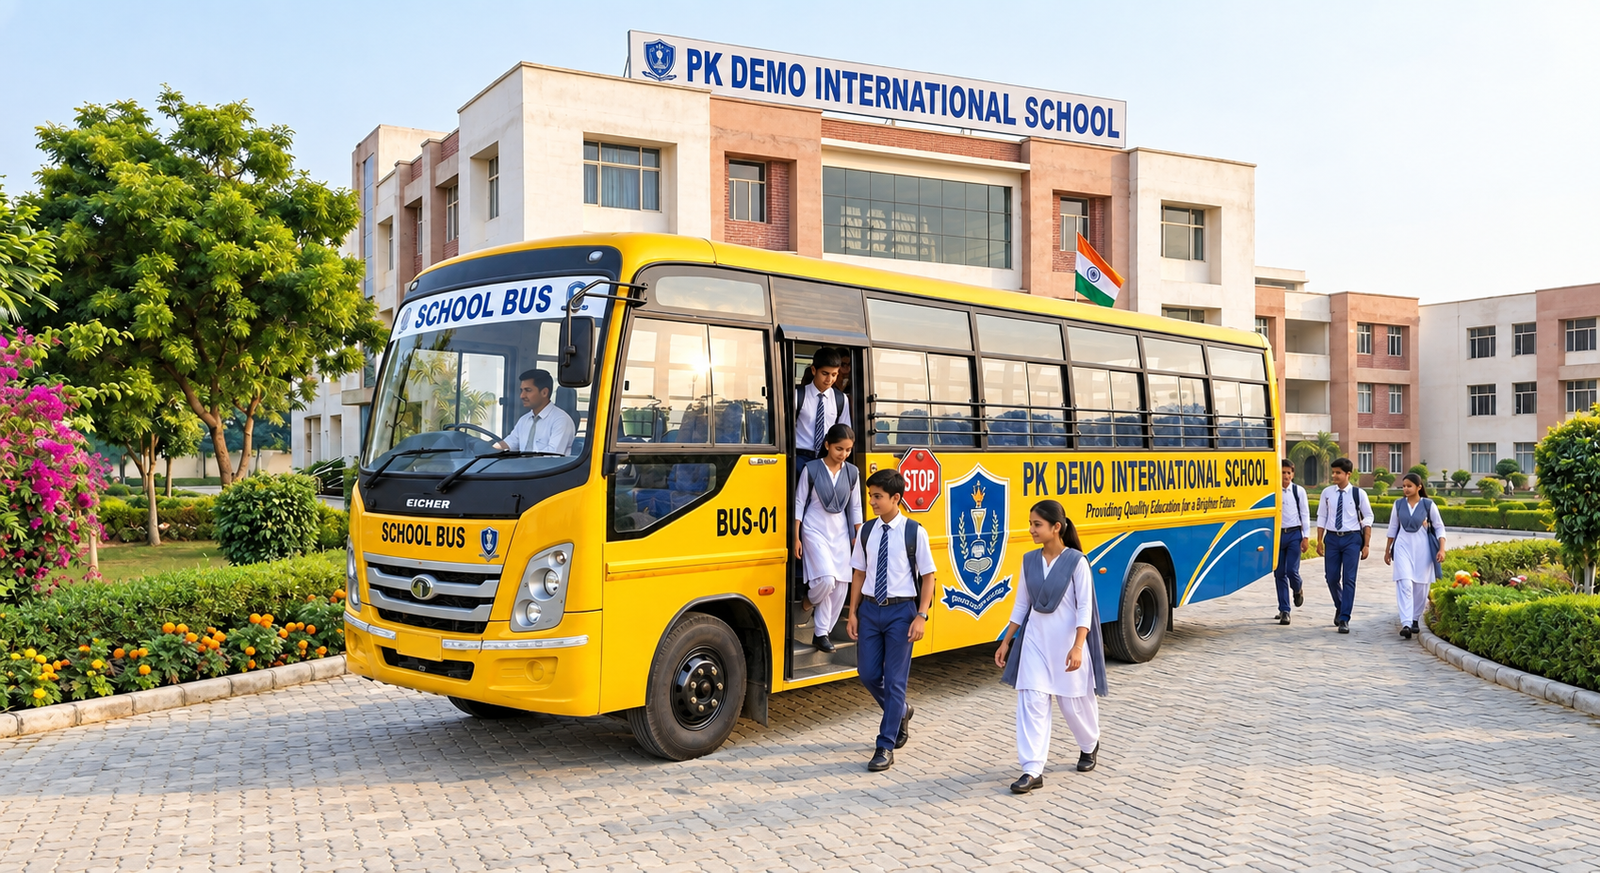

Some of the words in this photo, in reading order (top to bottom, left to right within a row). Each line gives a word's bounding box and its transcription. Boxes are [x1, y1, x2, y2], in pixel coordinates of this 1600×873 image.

[686, 48, 722, 86] PK
[731, 56, 806, 97] DEMO
[815, 67, 1016, 125] INTERNATIONAL
[1024, 95, 1120, 139] SCHOOL
[415, 292, 494, 329] SCHOOL
[501, 284, 553, 316] BUS
[904, 469, 935, 492] STOP
[1023, 461, 1049, 496] PK
[1056, 461, 1105, 495] DEMO
[1111, 460, 1221, 492] INTERNATIONAL
[1225, 459, 1269, 487] SCHOOL
[406, 499, 450, 509] EICHER
[1085, 502, 1122, 521] Providing
[1180, 498, 1190, 516] for
[1191, 501, 1195, 511] a
[382, 522, 431, 546] SCHOOL
[436, 525, 465, 548] BUS
[717, 506, 777, 536] BUS-01
